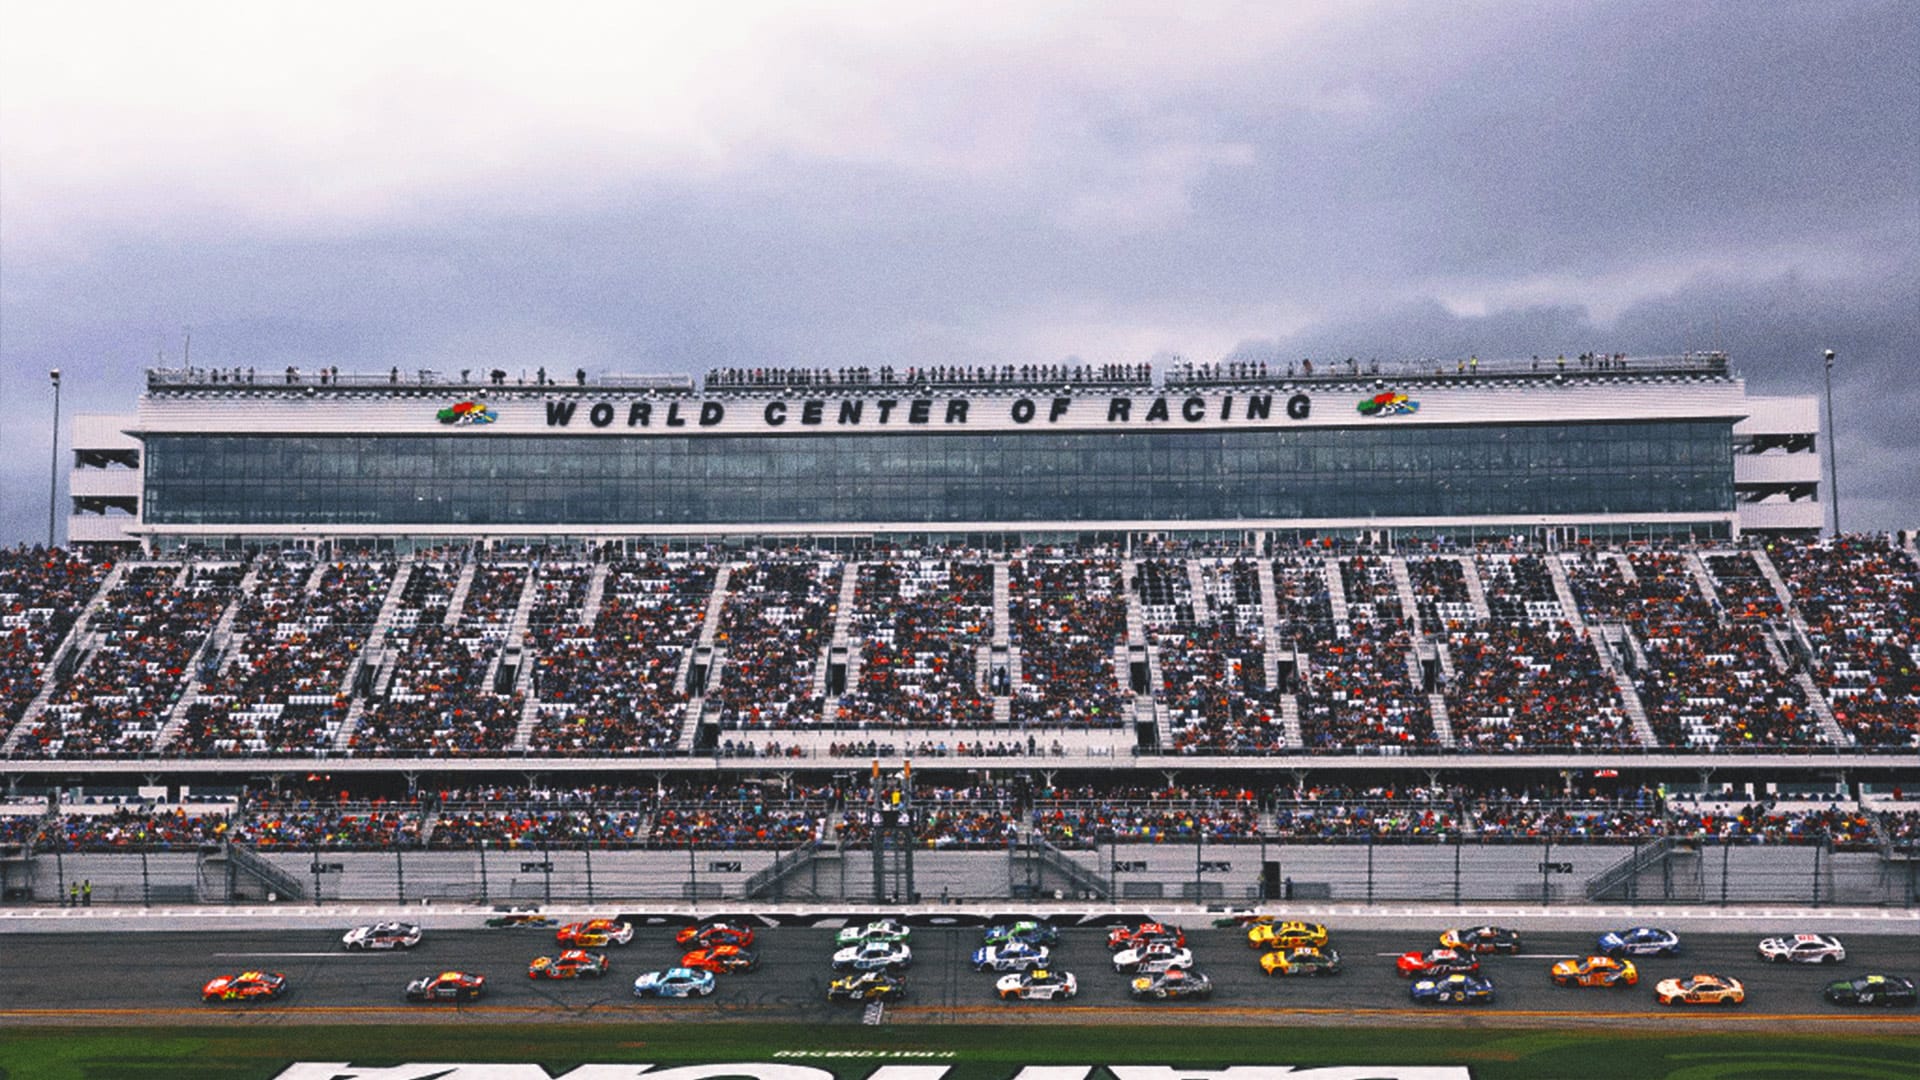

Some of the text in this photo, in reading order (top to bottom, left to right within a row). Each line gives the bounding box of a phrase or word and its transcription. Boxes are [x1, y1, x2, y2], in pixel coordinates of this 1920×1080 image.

[546, 394, 1312, 427] WORLD CENTER OF RACING
